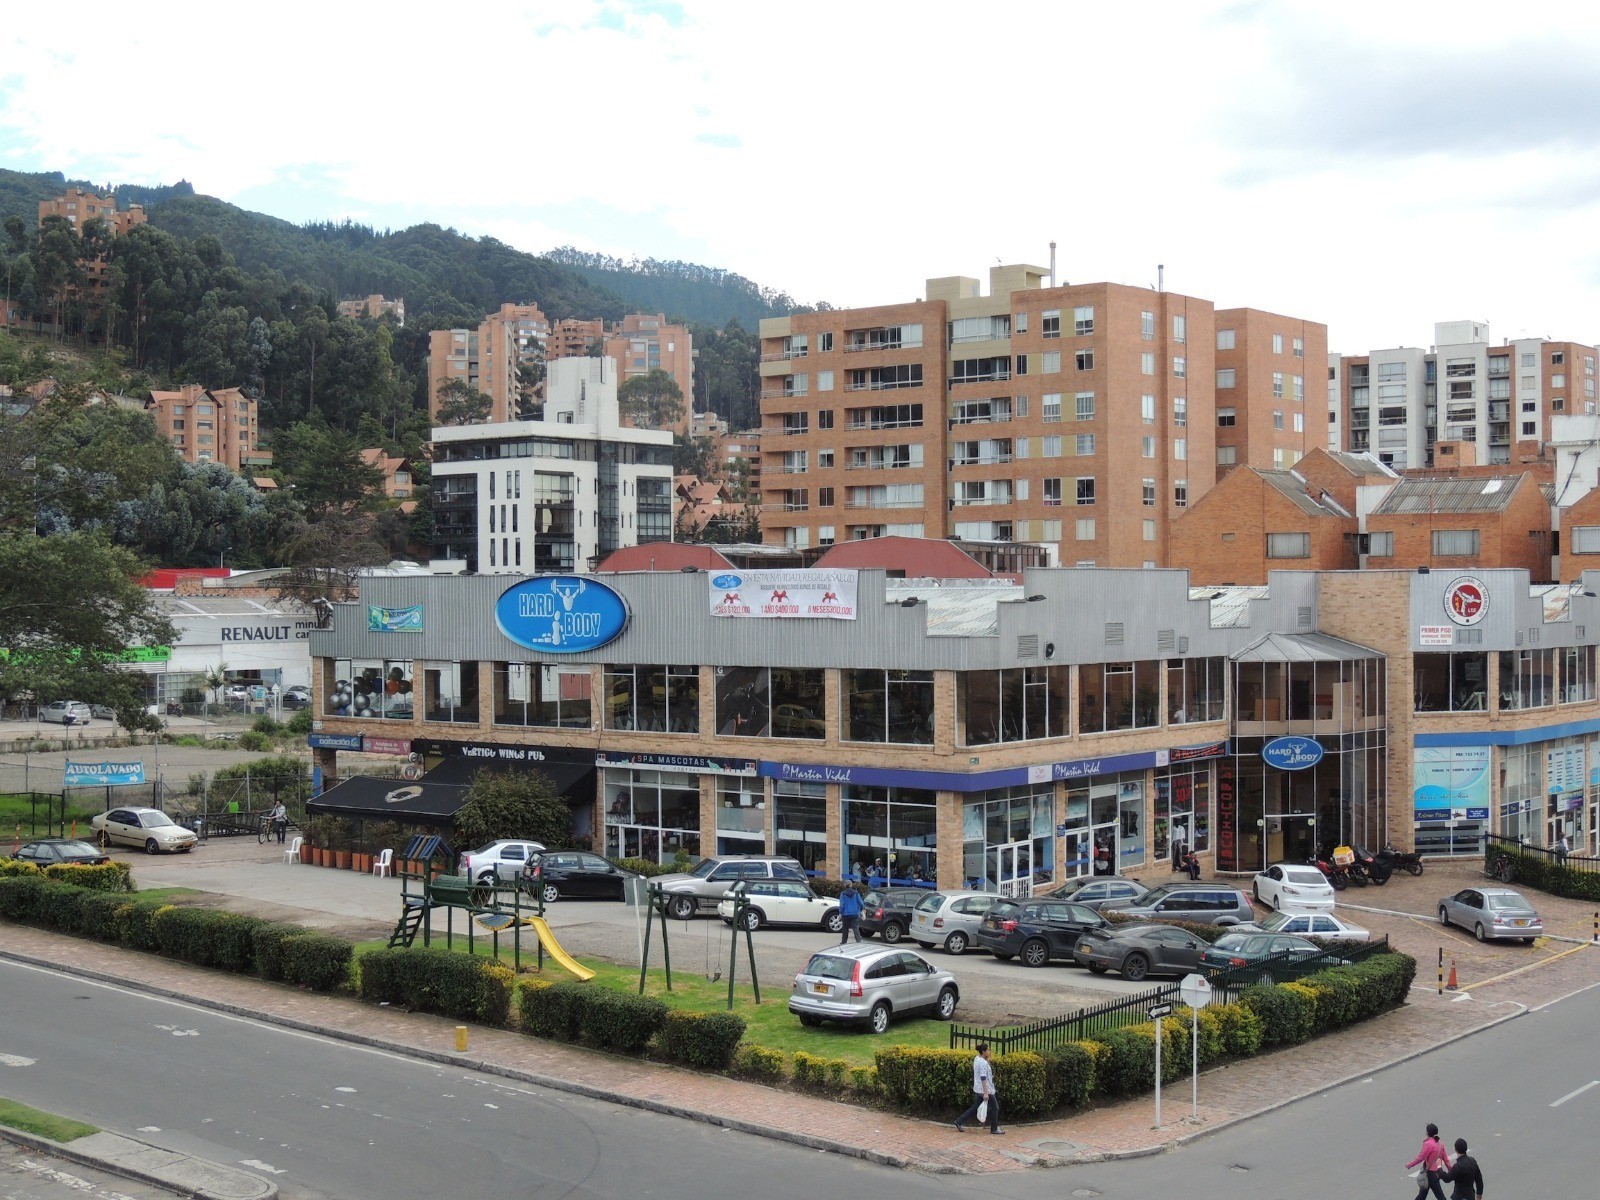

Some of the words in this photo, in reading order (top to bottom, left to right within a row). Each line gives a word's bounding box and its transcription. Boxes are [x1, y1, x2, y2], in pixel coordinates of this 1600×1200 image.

[519, 593, 555, 617] HARD
[564, 612, 601, 637] BODY
[221, 626, 291, 641] RENAULT
[1268, 748, 1292, 756] HARD
[1295, 753, 1319, 761] BODY
[637, 755, 654, 764] SPA
[657, 756, 705, 766] MASCOTAS
[66, 764, 141, 775] AUTOLAVADO
[825, 767, 851, 781] Vidal
[1083, 761, 1101, 775] Vidal
